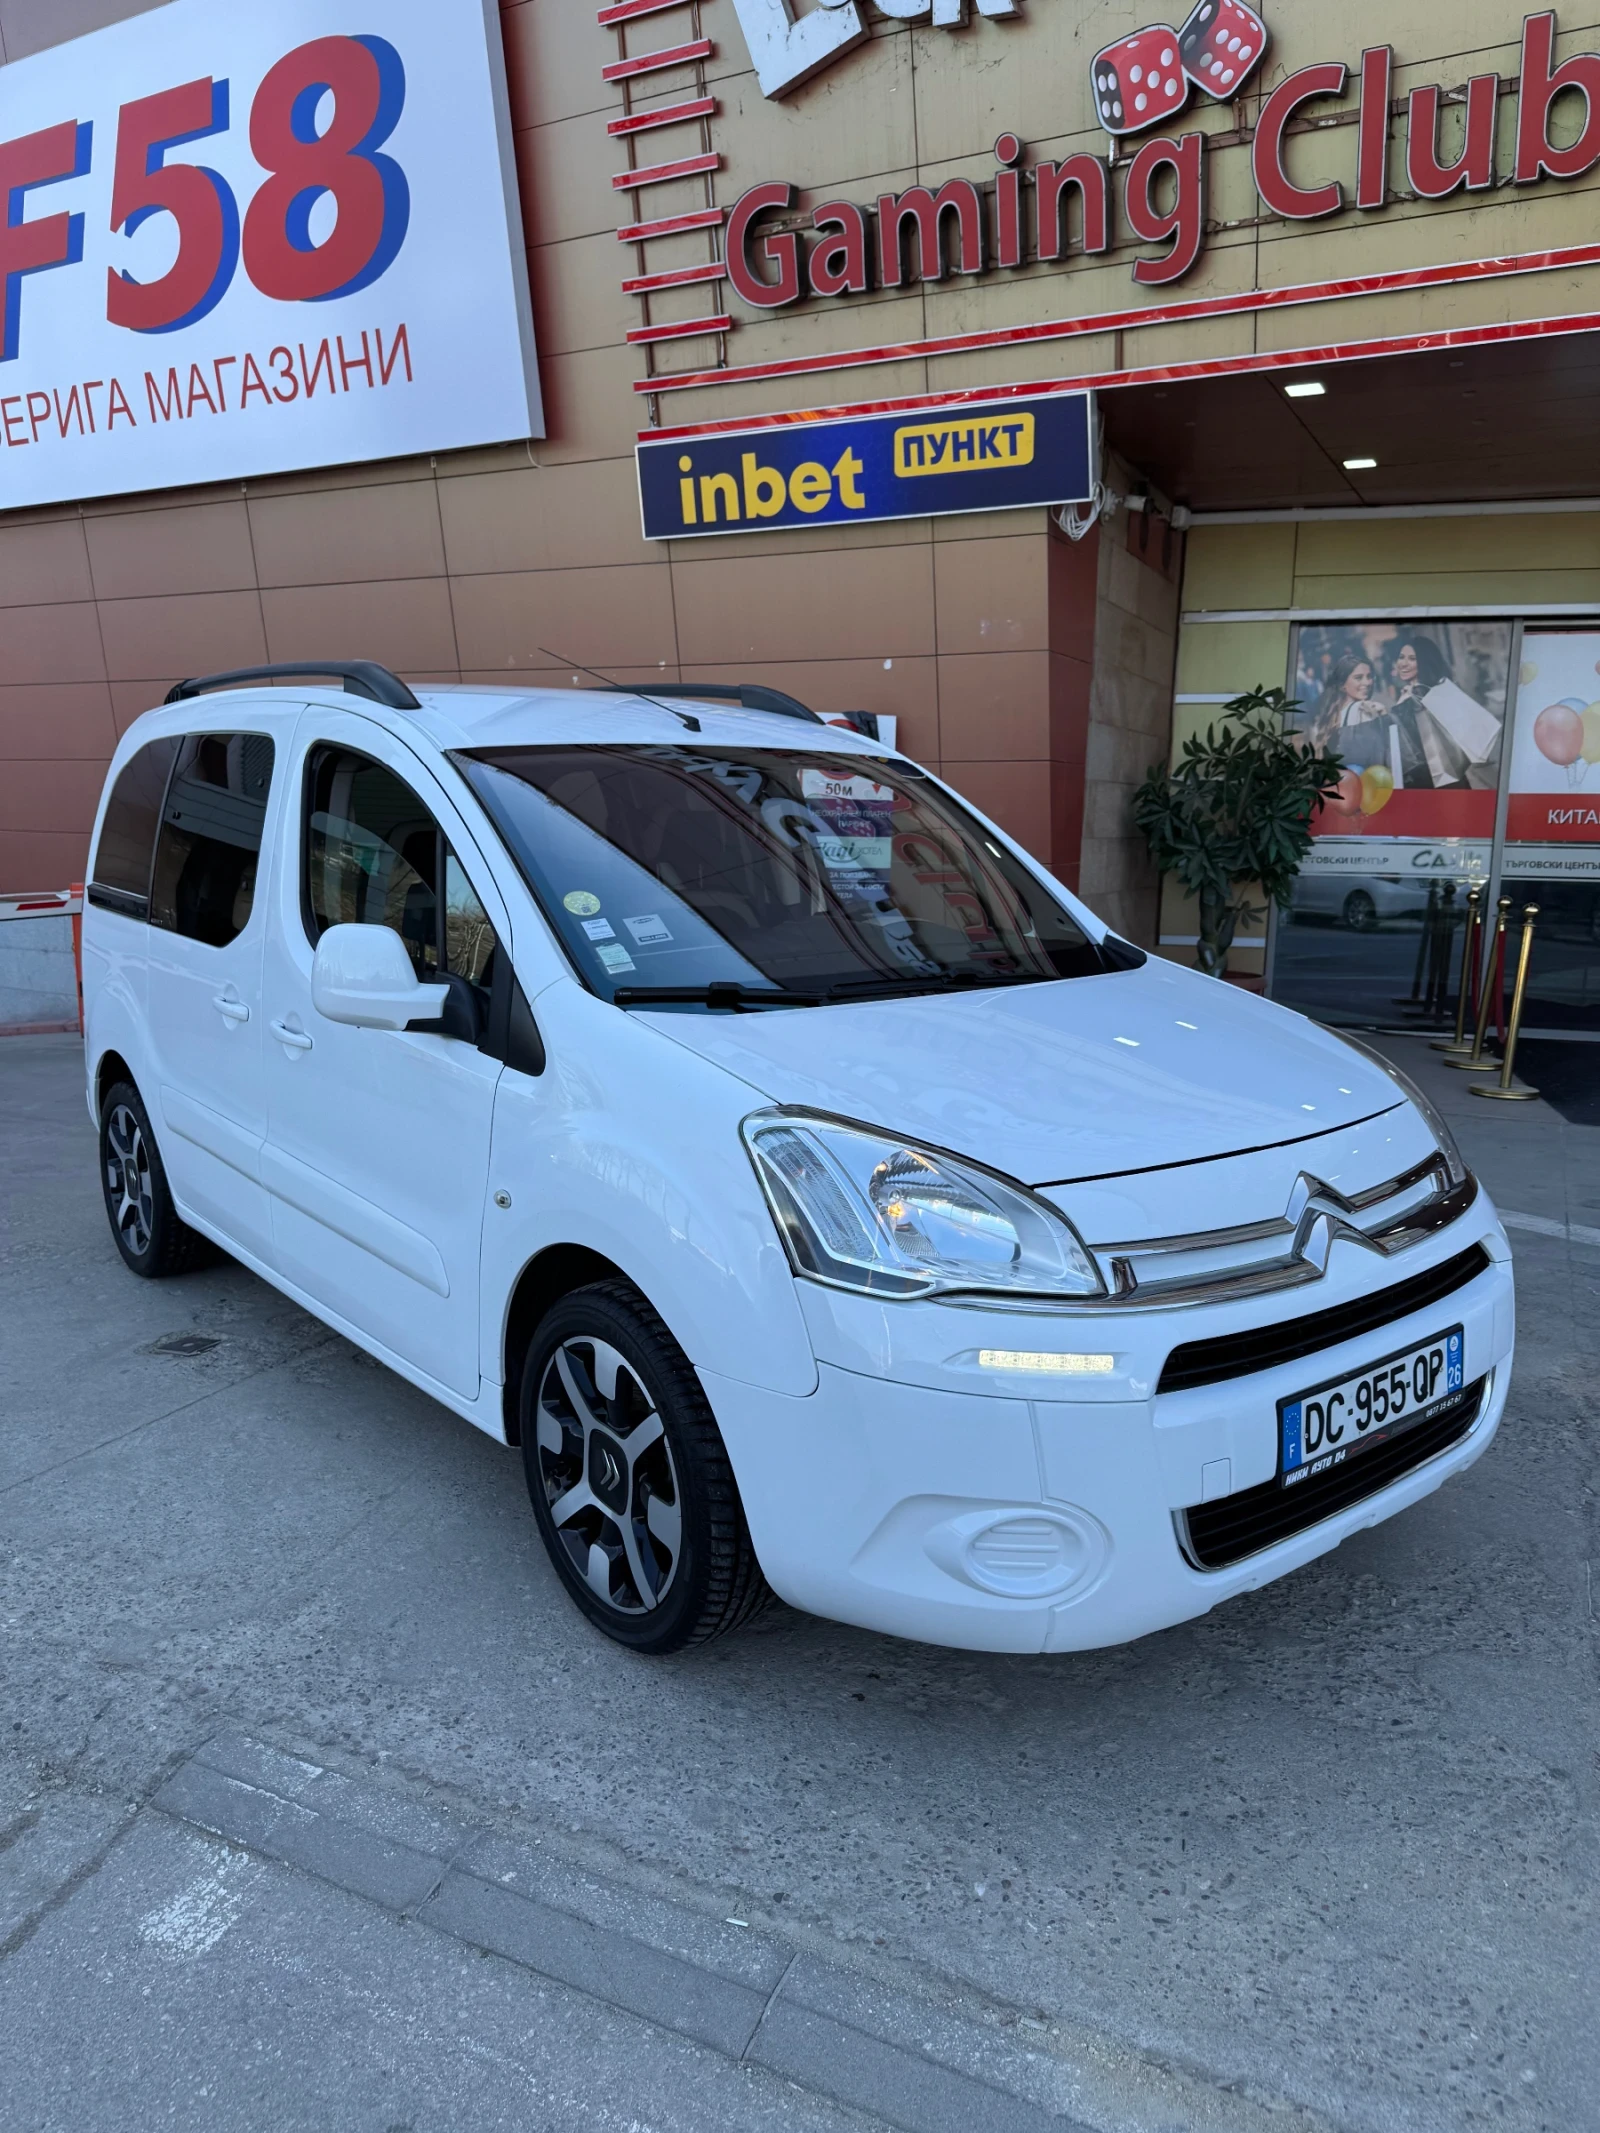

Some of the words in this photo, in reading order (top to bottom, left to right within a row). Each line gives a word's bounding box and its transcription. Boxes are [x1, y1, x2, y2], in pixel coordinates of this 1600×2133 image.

[724, 131, 1207, 309] Gaming
[1251, 9, 1600, 220] Club
[0, 378, 137, 447] ЕРИГА
[144, 323, 414, 424] МАГАЗИНИ
[902, 423, 1024, 469] ПУНКТ
[679, 446, 866, 525] inbet
[1547, 808, 1600, 825] КИТА
[1505, 859, 1563, 870] ТЪРГОВСКИ
[1448, 1363, 1462, 1388] 26
[1304, 1347, 1444, 1455] DC-955-QP
[1289, 1442, 1296, 1459] F
